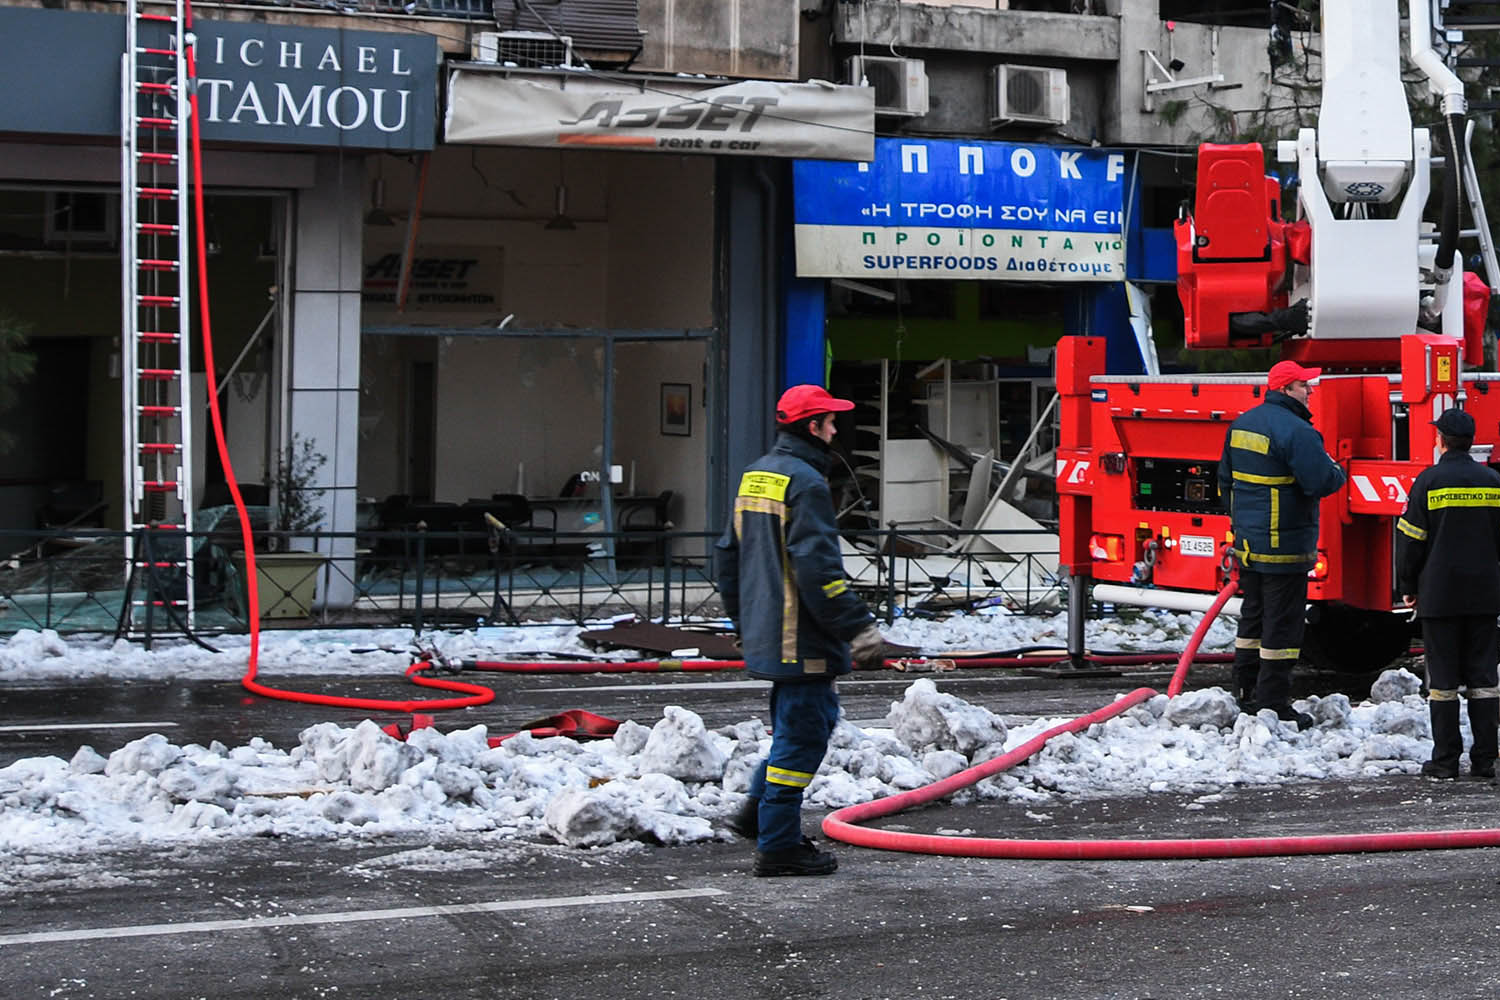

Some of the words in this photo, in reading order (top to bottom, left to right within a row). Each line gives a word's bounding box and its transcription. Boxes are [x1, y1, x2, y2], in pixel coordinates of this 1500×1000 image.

[659, 136, 703, 149] rent
[709, 138, 722, 149] a
[728, 139, 761, 150] car
[901, 203, 993, 219] ΤΡΟΦΗ
[1001, 206, 1048, 221] ΣΟΥ
[1055, 209, 1086, 223] ΝΑ
[862, 229, 1073, 250] ΠΡΟΪΟΝΤΑ
[863, 255, 998, 271] SUPERFOODS
[1006, 257, 1112, 276] Διαθέτουμε
